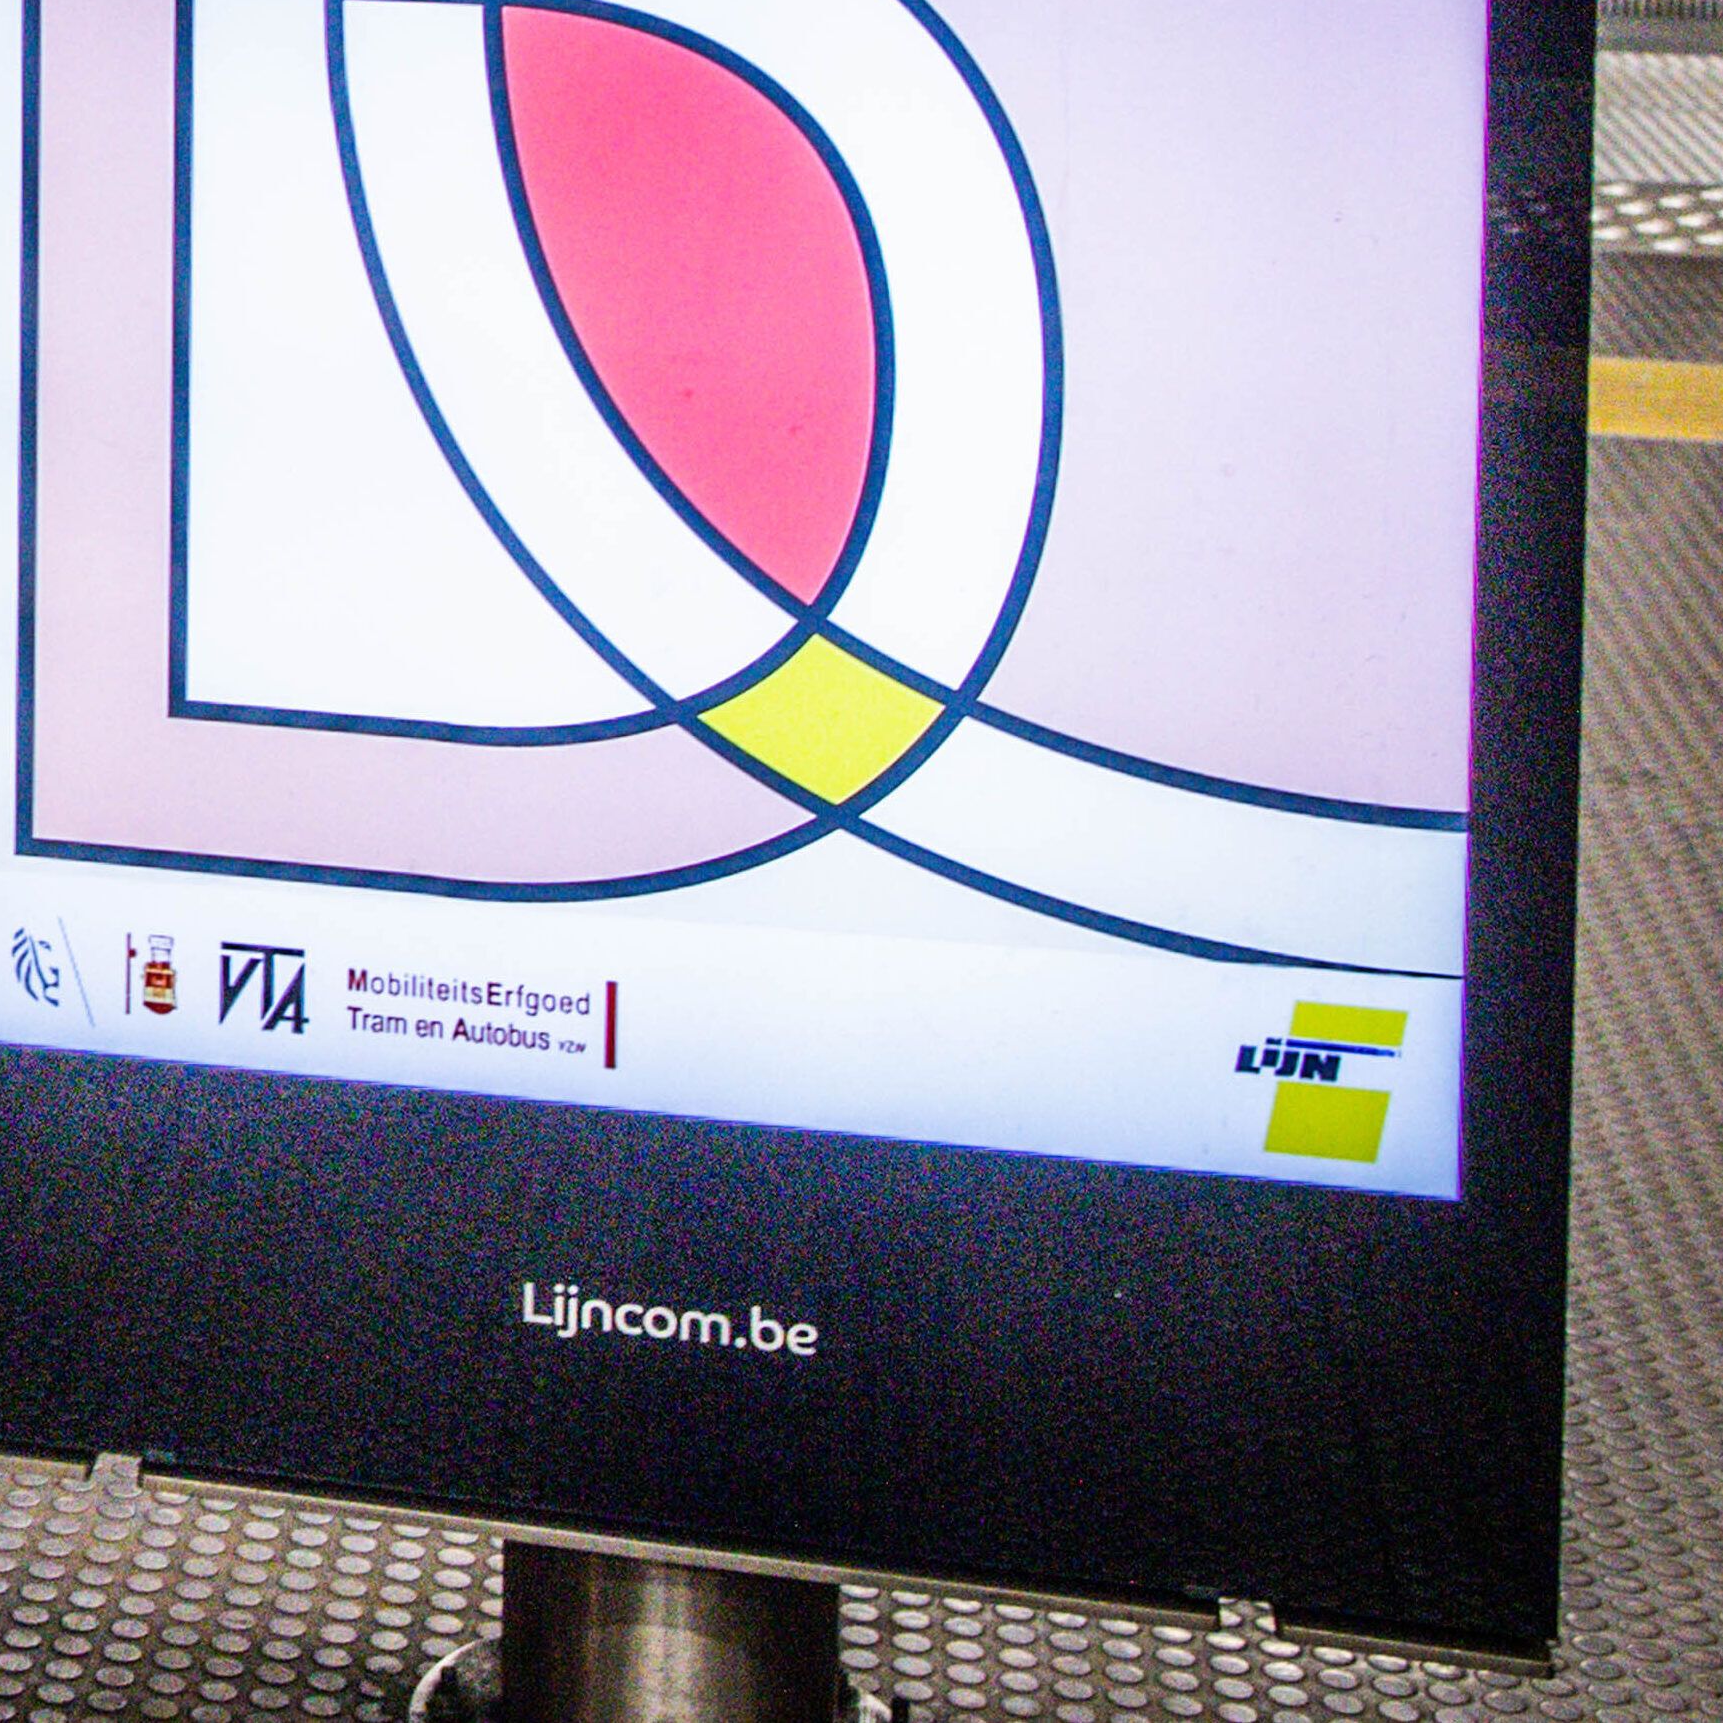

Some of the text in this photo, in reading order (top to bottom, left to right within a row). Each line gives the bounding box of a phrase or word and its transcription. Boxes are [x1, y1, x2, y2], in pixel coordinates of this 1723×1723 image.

[346, 967, 592, 1017] MobiliteitsErfgoed
[346, 1005, 410, 1037] Tram
[414, 1018, 444, 1039] en
[451, 1017, 551, 1051] Autobus
[522, 1281, 819, 1355] Lijncom.be
